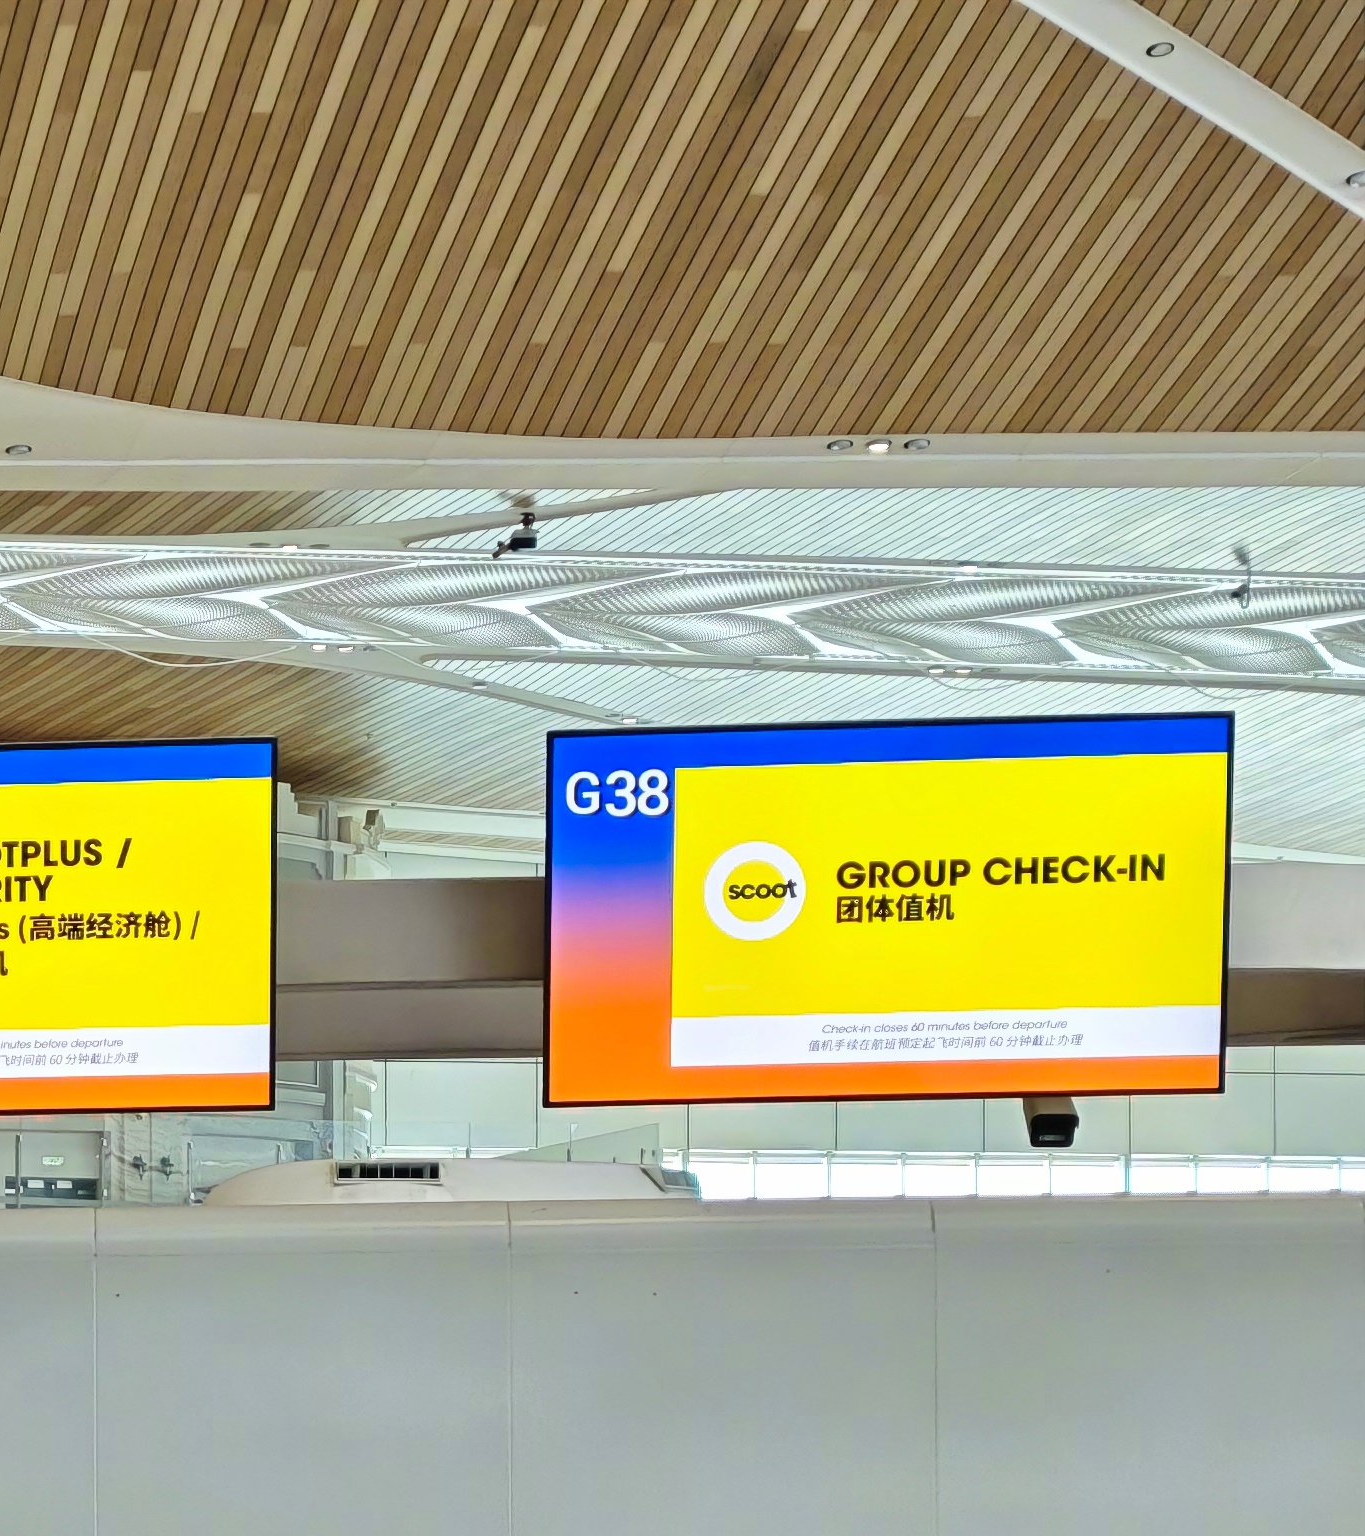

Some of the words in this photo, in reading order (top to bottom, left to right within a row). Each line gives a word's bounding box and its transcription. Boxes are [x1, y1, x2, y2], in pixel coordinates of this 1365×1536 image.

[566, 771, 669, 817] G38
[836, 859, 970, 889] GROUP
[983, 853, 1166, 885] CHECK-IN
[728, 878, 798, 901] scoot
[836, 895, 955, 924] 团体值机
[821, 1024, 871, 1034] Check-in
[873, 1023, 908, 1033] closes
[911, 1022, 925, 1033] 60
[927, 1022, 971, 1032] minutes
[973, 1021, 1009, 1031] before
[1011, 1019, 1067, 1033] departure
[34, 1039, 68, 1049] before
[70, 1038, 124, 1051] departure
